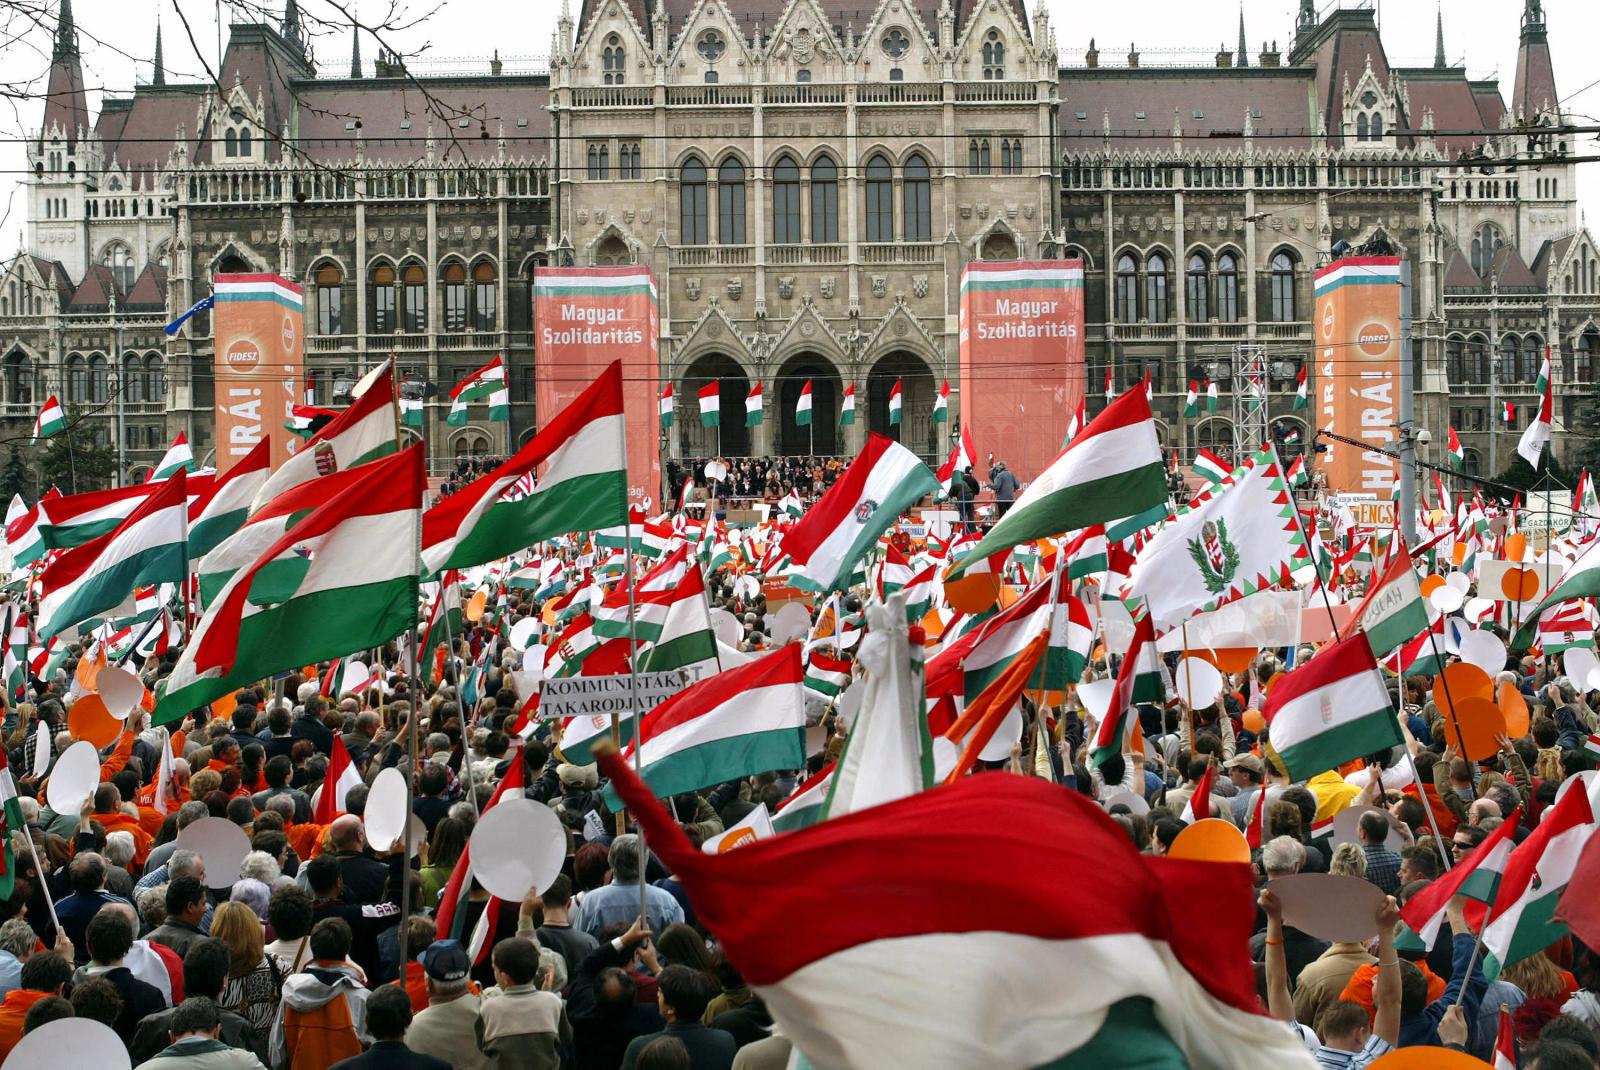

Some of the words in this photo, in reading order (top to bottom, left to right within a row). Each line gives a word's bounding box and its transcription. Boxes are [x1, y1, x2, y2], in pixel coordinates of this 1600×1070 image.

[561, 304, 624, 325] Magyar
[996, 299, 1058, 318] Magyar
[543, 326, 642, 344] Szolidaritás
[977, 320, 1077, 339] Szolidaritás
[1360, 335, 1389, 344] FIDESZ
[229, 351, 257, 361] FIDESZ
